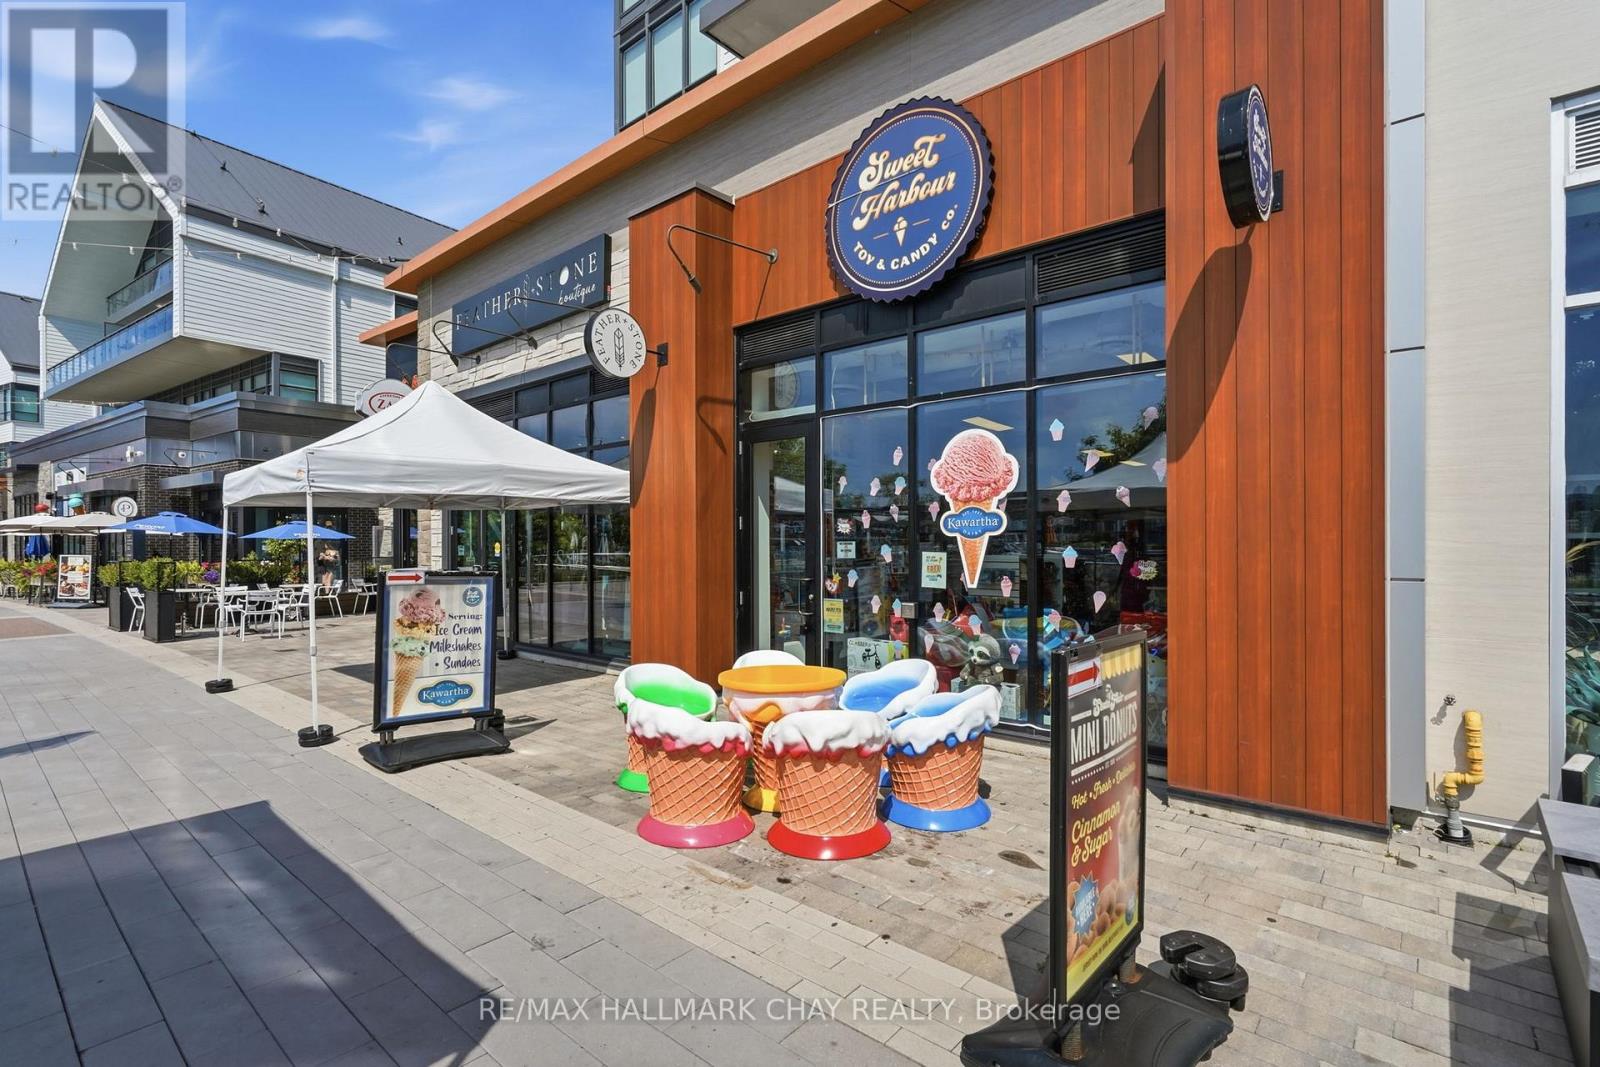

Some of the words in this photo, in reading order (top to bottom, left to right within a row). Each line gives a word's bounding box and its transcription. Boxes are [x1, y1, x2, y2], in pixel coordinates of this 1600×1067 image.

[858, 133, 947, 192] Sweet
[852, 170, 957, 231] Harbour
[853, 241, 874, 265] TOY
[876, 257, 886, 271] &
[891, 233, 939, 270] CANDY
[559, 283, 596, 305] boutique
[947, 517, 999, 530] Kawartha
[429, 637, 482, 654] Milkshakes
[435, 624, 449, 636] Ice
[453, 624, 482, 636] Cream
[443, 655, 481, 670] Sundaes
[423, 687, 469, 700] Kawartha
[1071, 718, 1100, 765] MINI
[1103, 701, 1138, 750] DONUTS
[1071, 791, 1088, 809] Hot
[1093, 778, 1113, 800] Fresh
[1071, 800, 1121, 844] Cinnamon
[1071, 844, 1081, 868] &
[1082, 827, 1113, 863] Sugar
